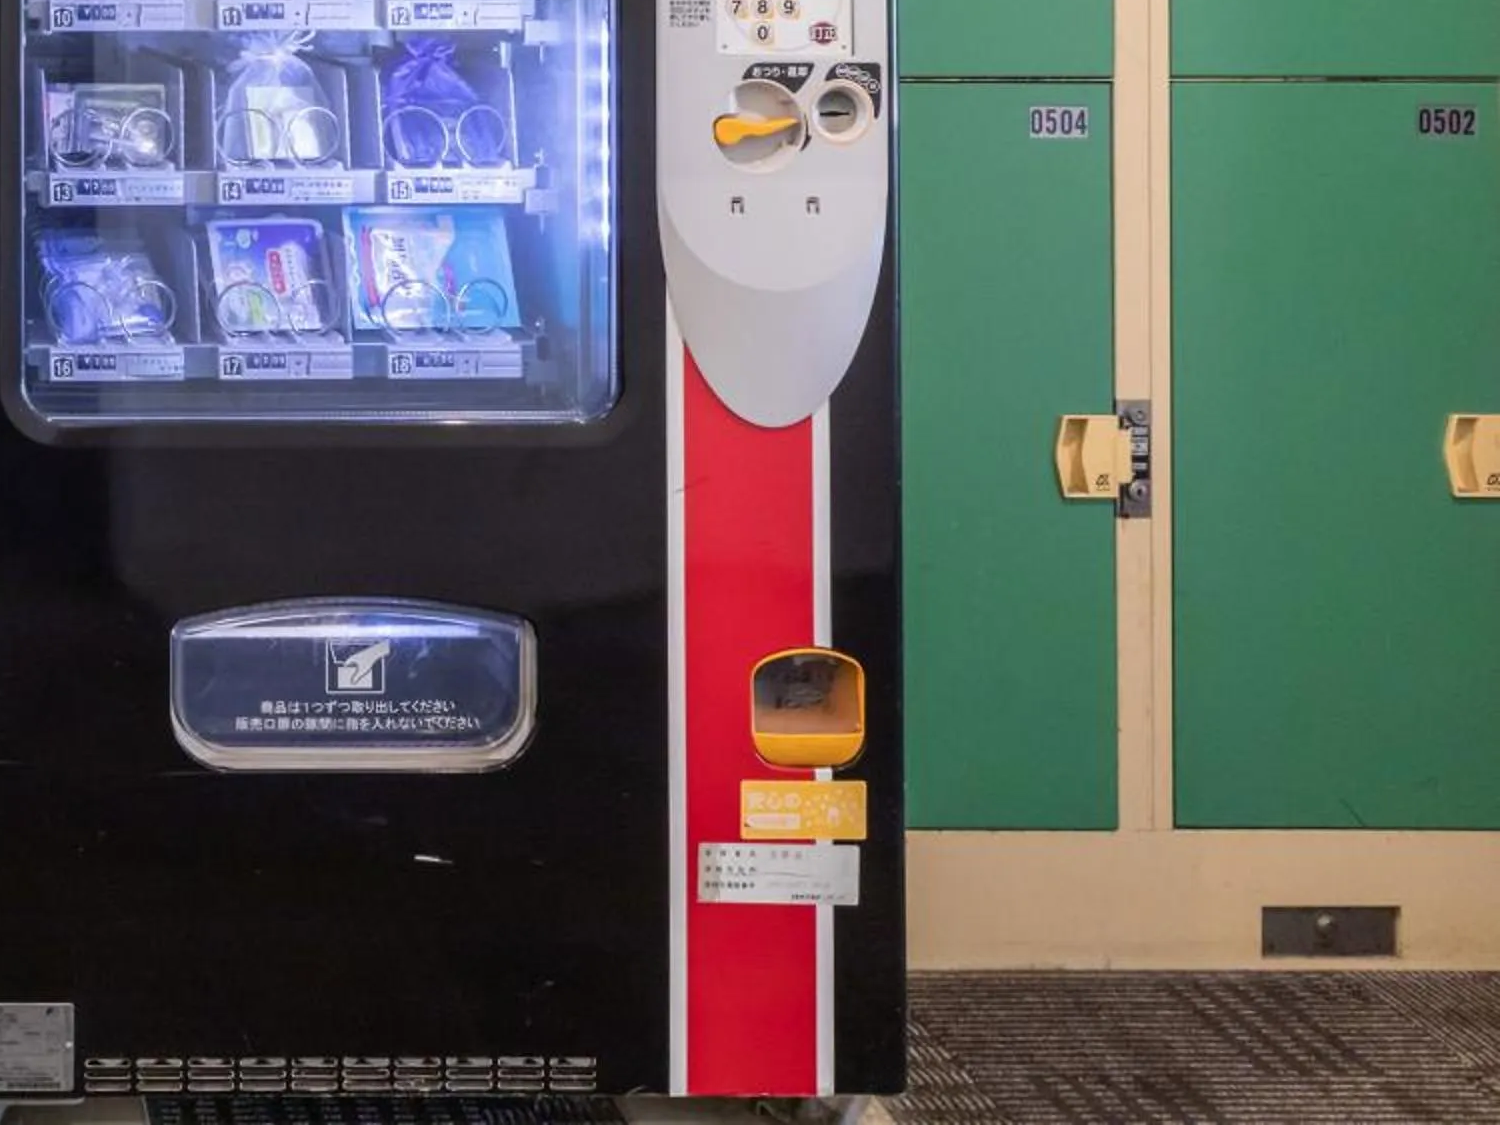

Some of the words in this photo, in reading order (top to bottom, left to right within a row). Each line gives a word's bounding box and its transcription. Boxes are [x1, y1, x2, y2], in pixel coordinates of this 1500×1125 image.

[731, 0, 741, 14] 7
[757, 0, 768, 14] 8
[783, 0, 794, 14] 9
[757, 26, 768, 40] 0
[1030, 108, 1087, 135] 0504
[1418, 108, 1476, 136] 0502
[260, 700, 455, 715] 商品は1つずつ取り出してください
